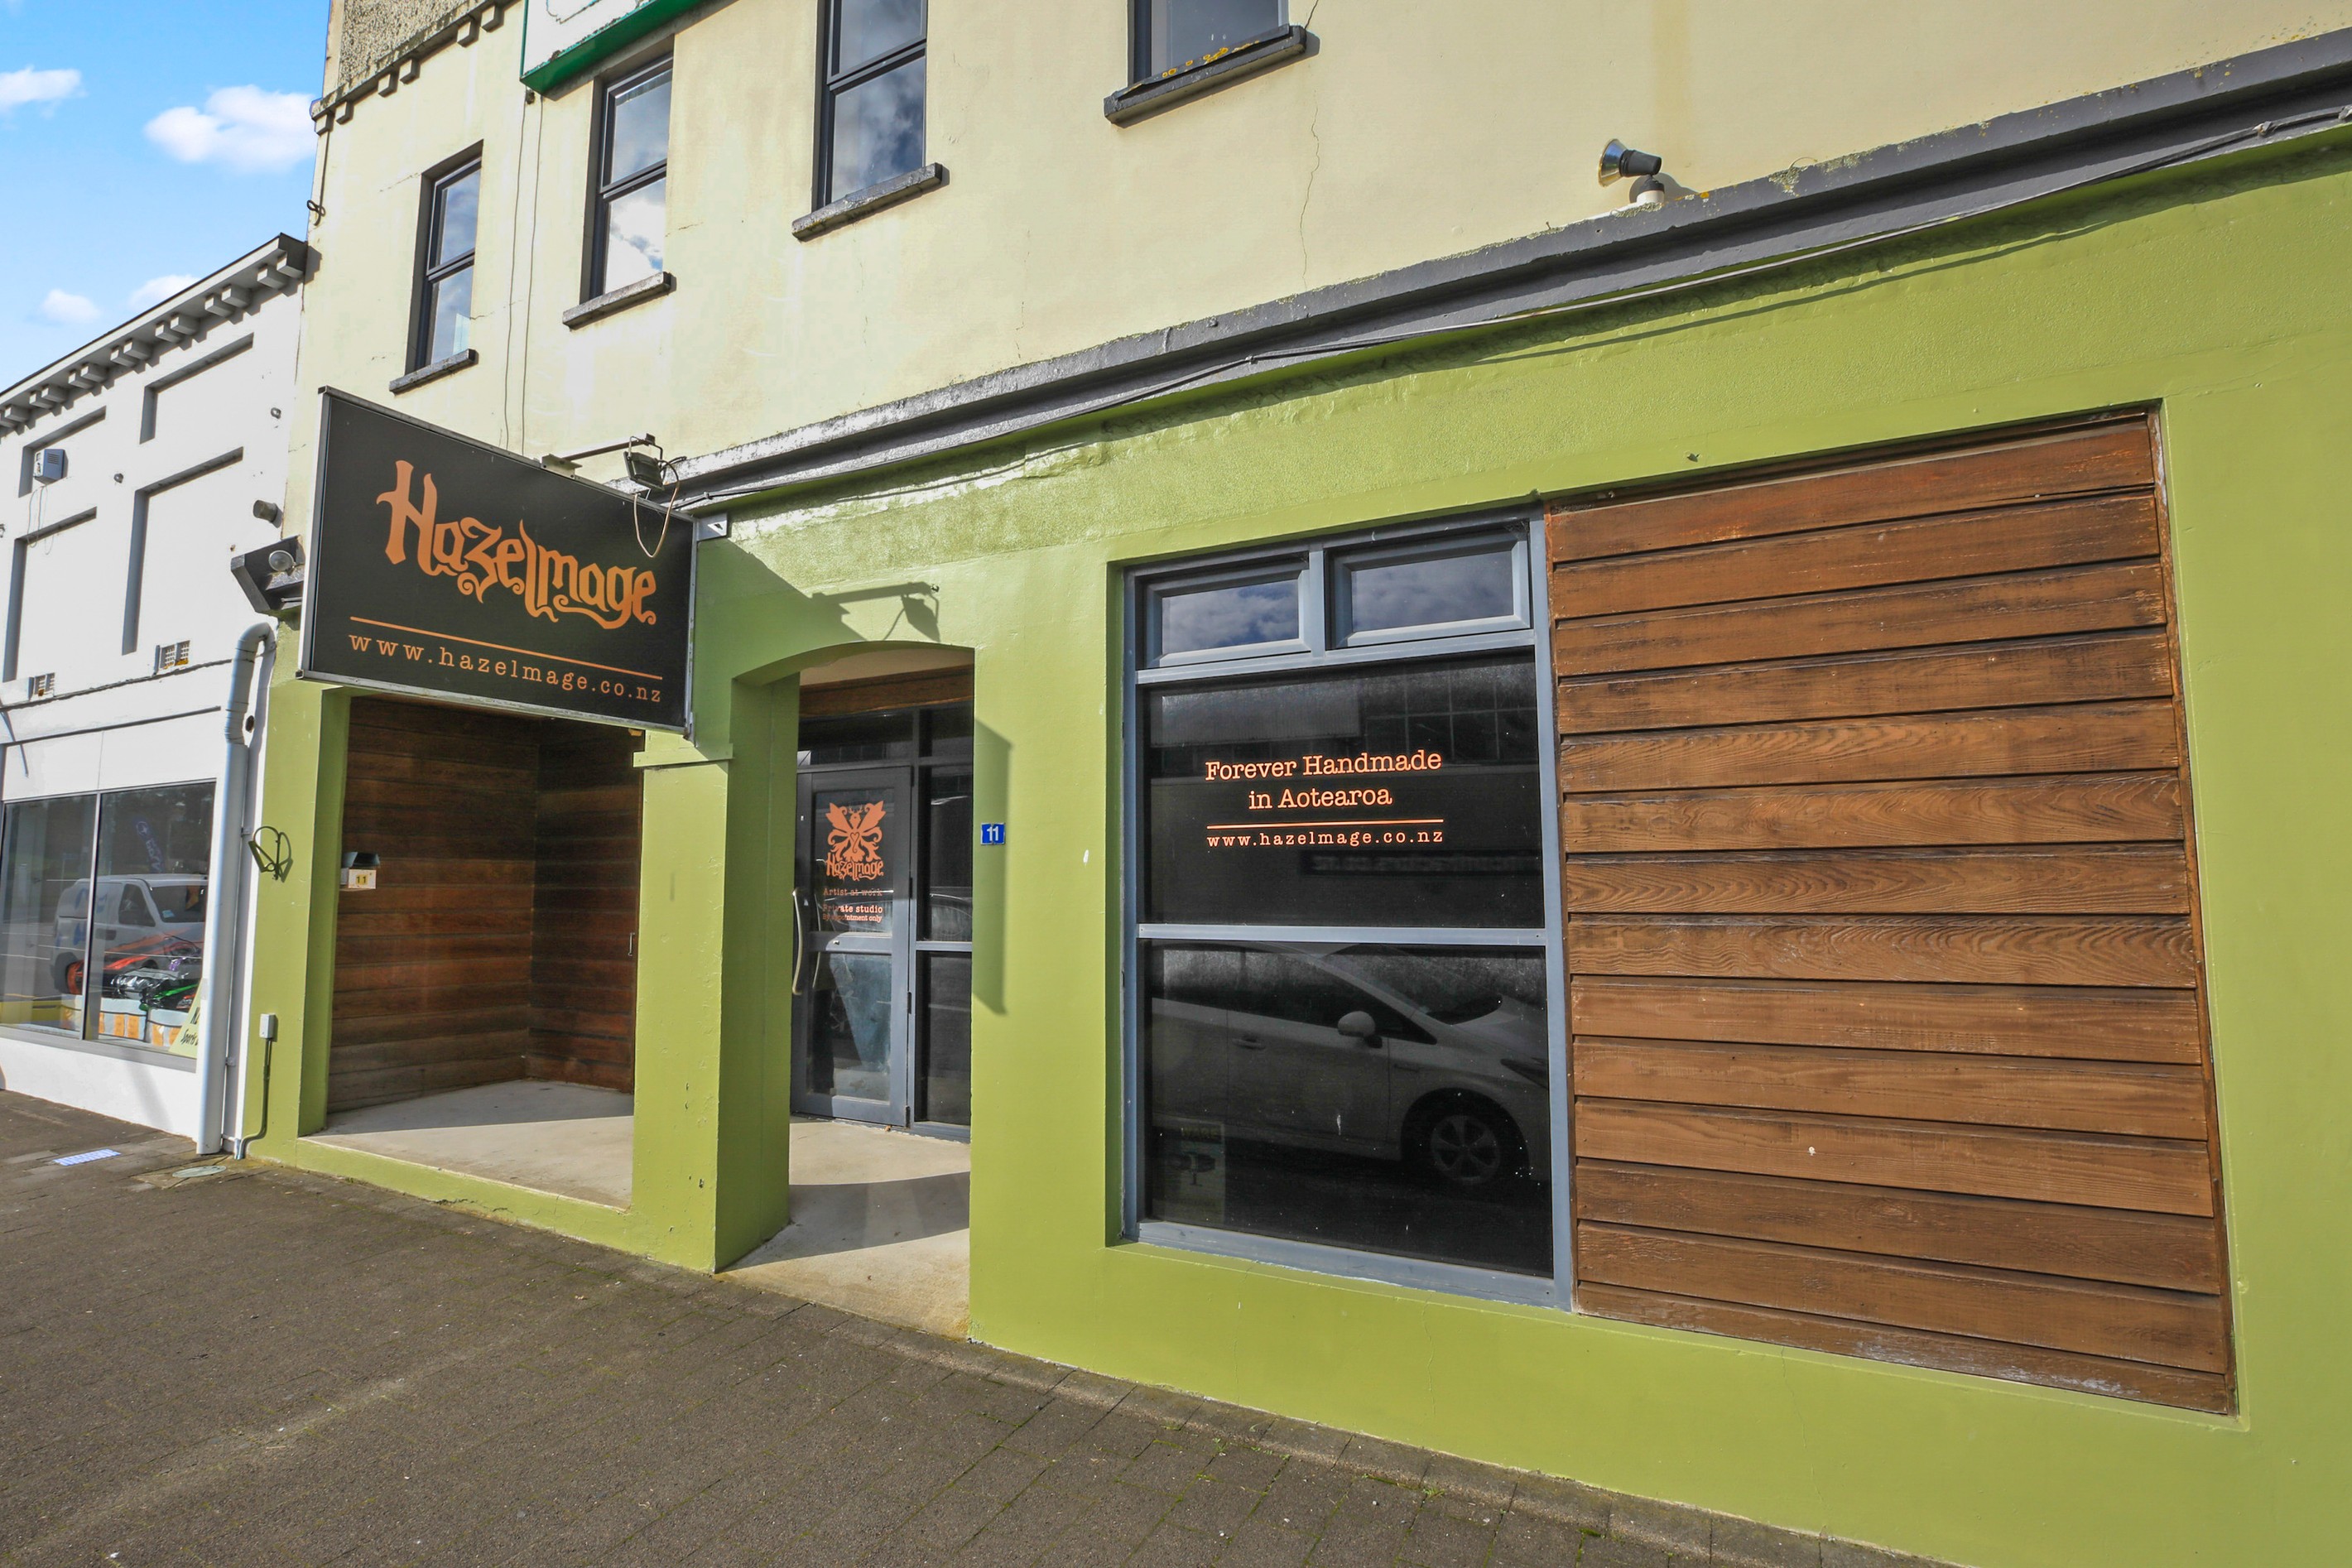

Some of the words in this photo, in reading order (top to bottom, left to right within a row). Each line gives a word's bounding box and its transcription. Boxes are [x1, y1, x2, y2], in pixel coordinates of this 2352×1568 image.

[376, 459, 657, 629] Hazelmage
[348, 632, 662, 703] www.hazelmage.co.nz
[1205, 760, 1297, 781] Forever
[1302, 748, 1442, 777] Handmade
[1248, 791, 1272, 810] in
[1277, 787, 1393, 810] Aotearoa
[986, 825, 999, 841] 11
[1206, 830, 1444, 848] www.hazelmage.co.nz
[825, 852, 884, 881] Hazelmage
[356, 876, 367, 884] 11
[823, 887, 848, 897] Artist
[849, 888, 859, 897] at
[862, 887, 883, 897] work
[822, 904, 854, 913] Private
[855, 905, 883, 914] studio
[868, 914, 883, 923] only
